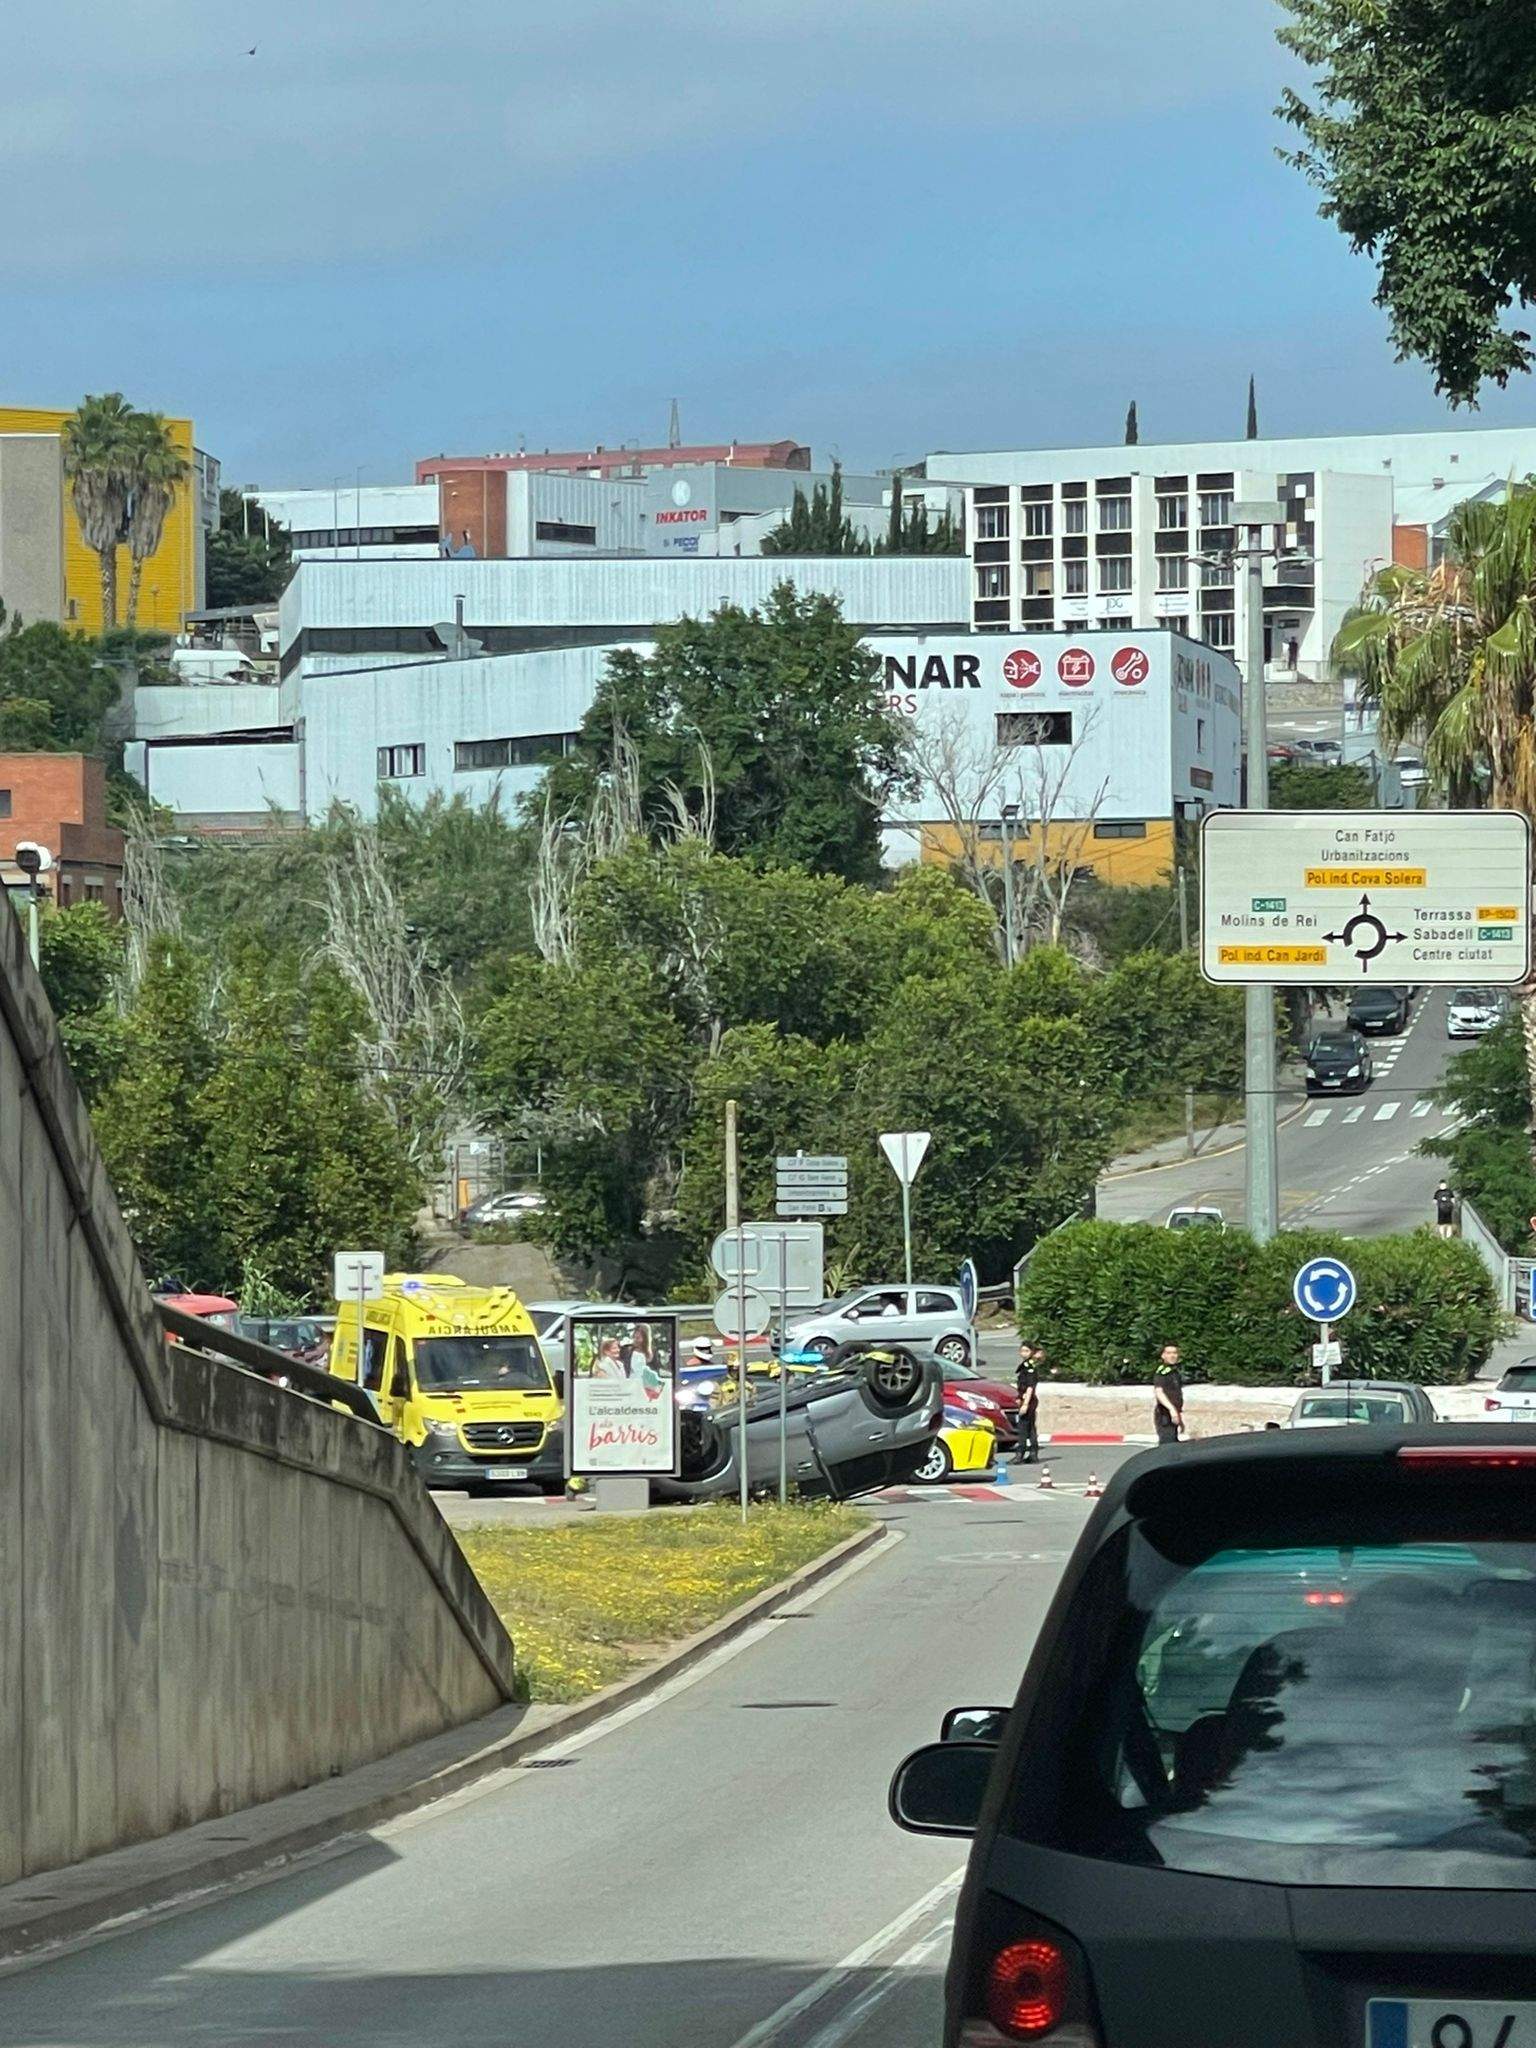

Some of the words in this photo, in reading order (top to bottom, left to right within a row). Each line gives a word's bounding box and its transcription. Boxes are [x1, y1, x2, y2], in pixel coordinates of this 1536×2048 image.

[655, 509, 707, 524] INKATOR
[888, 694, 918, 714] RS
[1335, 829, 1359, 842] Can
[1365, 829, 1395, 844] Fatjó
[1321, 849, 1410, 861] Urbanitzacions
[1351, 872, 1381, 885] Cova
[1385, 872, 1423, 885] Solera
[1221, 914, 1265, 927] Molins
[1272, 914, 1289, 927] de
[1296, 914, 1318, 927] Rei
[1414, 908, 1472, 921] Terrassa
[1413, 928, 1473, 940] Sabadell
[1267, 950, 1290, 961] Can
[1413, 948, 1452, 960] Centre
[1458, 948, 1493, 960] ciutat
[588, 1405, 658, 1416] L'alcaldessa
[588, 1422, 658, 1451] barris
